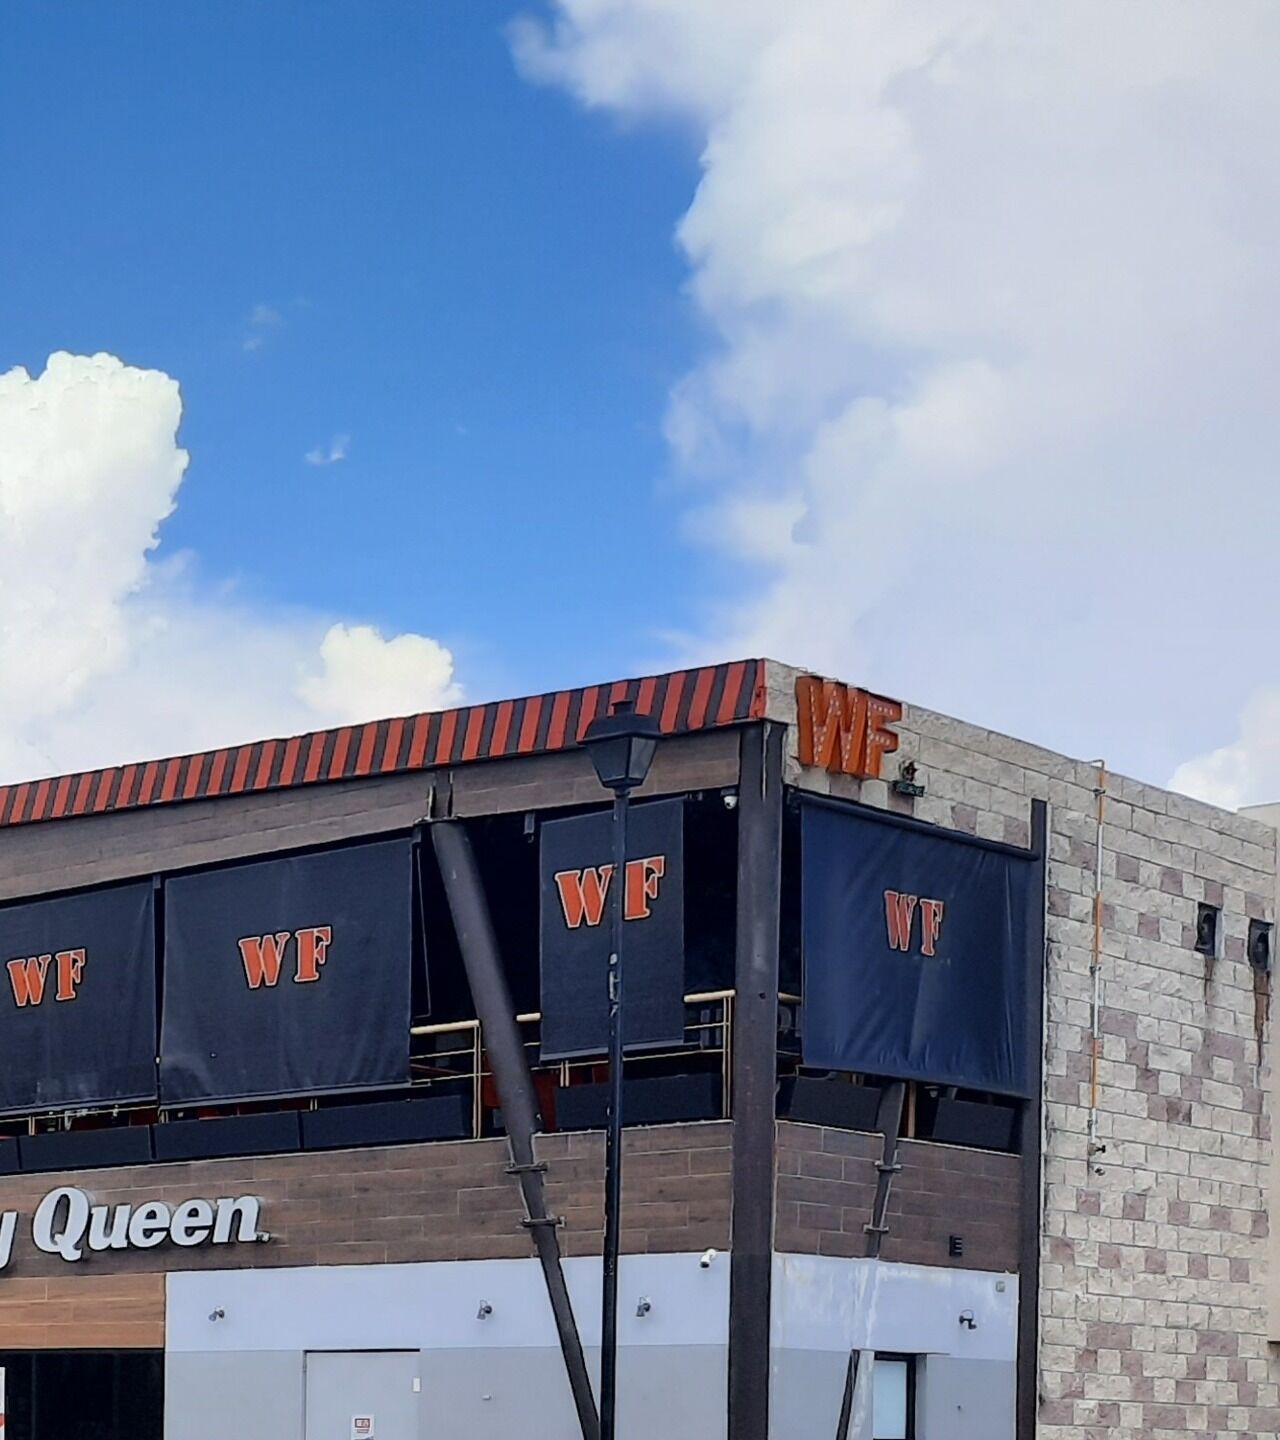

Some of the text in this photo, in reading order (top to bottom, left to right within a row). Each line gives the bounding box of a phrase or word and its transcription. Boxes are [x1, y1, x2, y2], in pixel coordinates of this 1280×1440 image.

[795, 675, 903, 780] WF
[553, 854, 666, 930] WF
[883, 889, 946, 957] WF
[6, 948, 87, 1008] WF
[237, 925, 333, 989] WF
[33, 1186, 263, 1263] Queen
